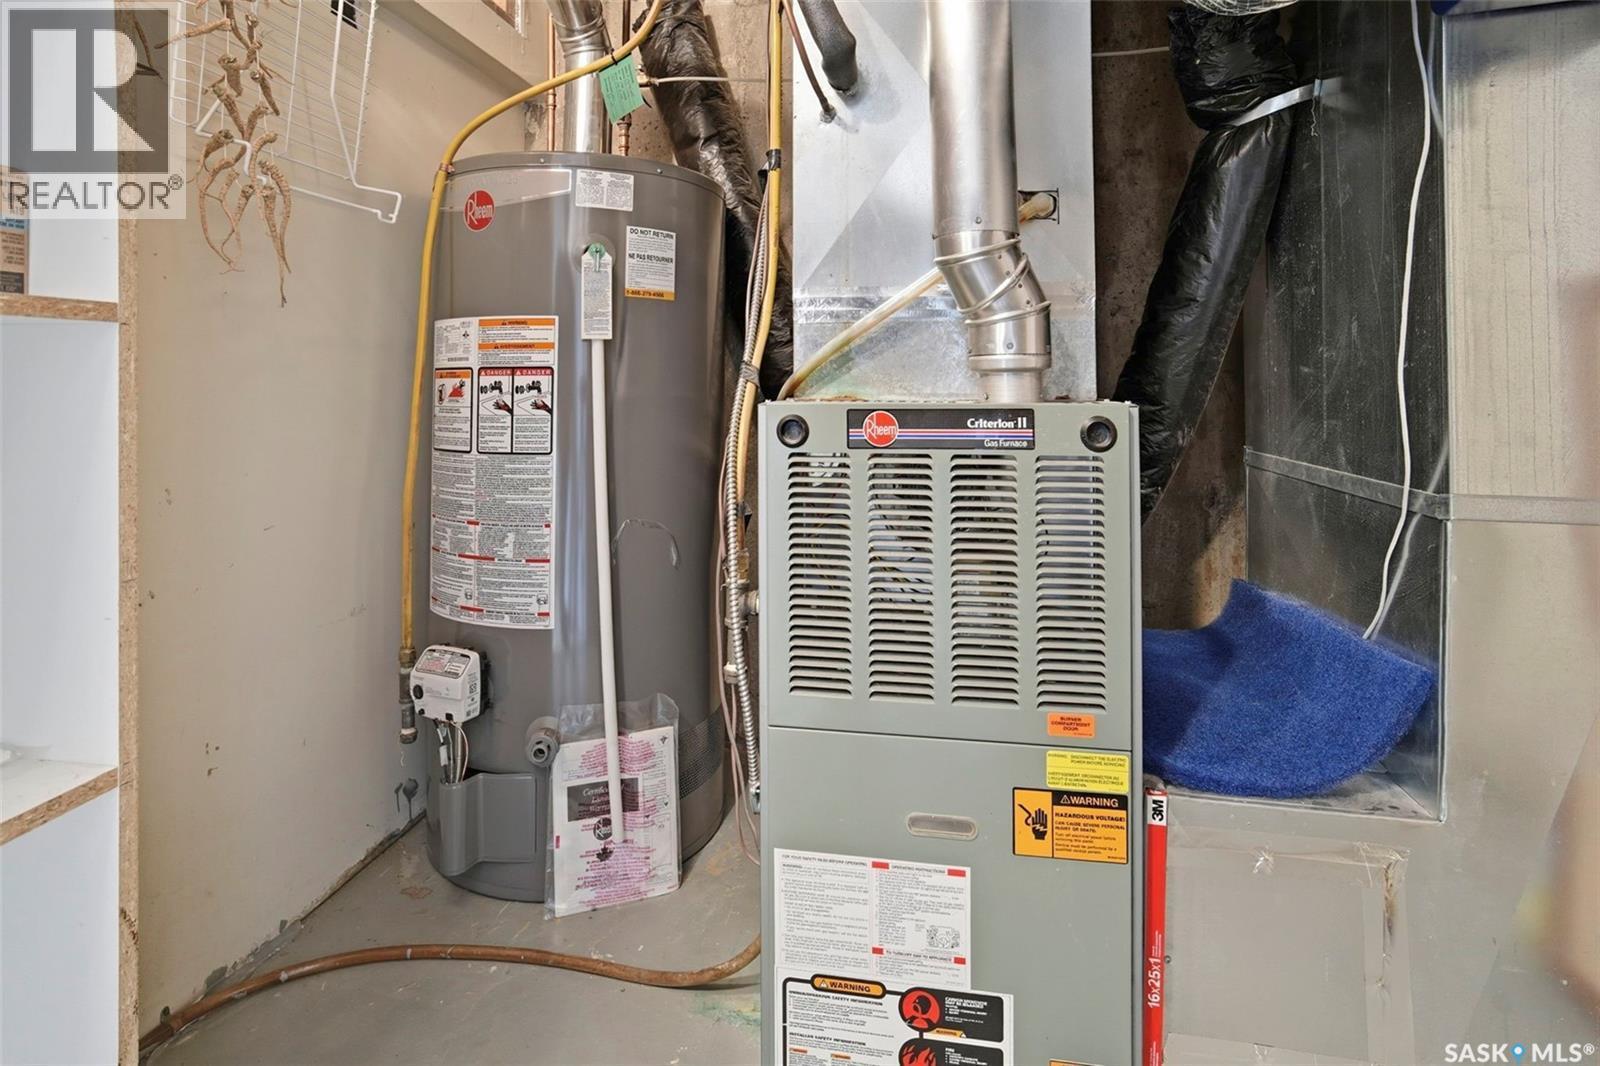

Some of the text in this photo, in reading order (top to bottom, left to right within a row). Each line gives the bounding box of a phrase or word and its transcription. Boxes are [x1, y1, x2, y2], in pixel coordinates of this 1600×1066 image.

[466, 192, 494, 225] Rheem
[629, 227, 639, 235] DO
[866, 412, 898, 439] Rheem
[966, 417, 1028, 429] Criterion II
[984, 438, 1028, 448] Gas Furnace
[1070, 796, 1119, 808] WARNING
[1151, 799, 1164, 822] 3M
[829, 981, 871, 993] WARNING
[1148, 957, 1161, 1008] 16x25x1
